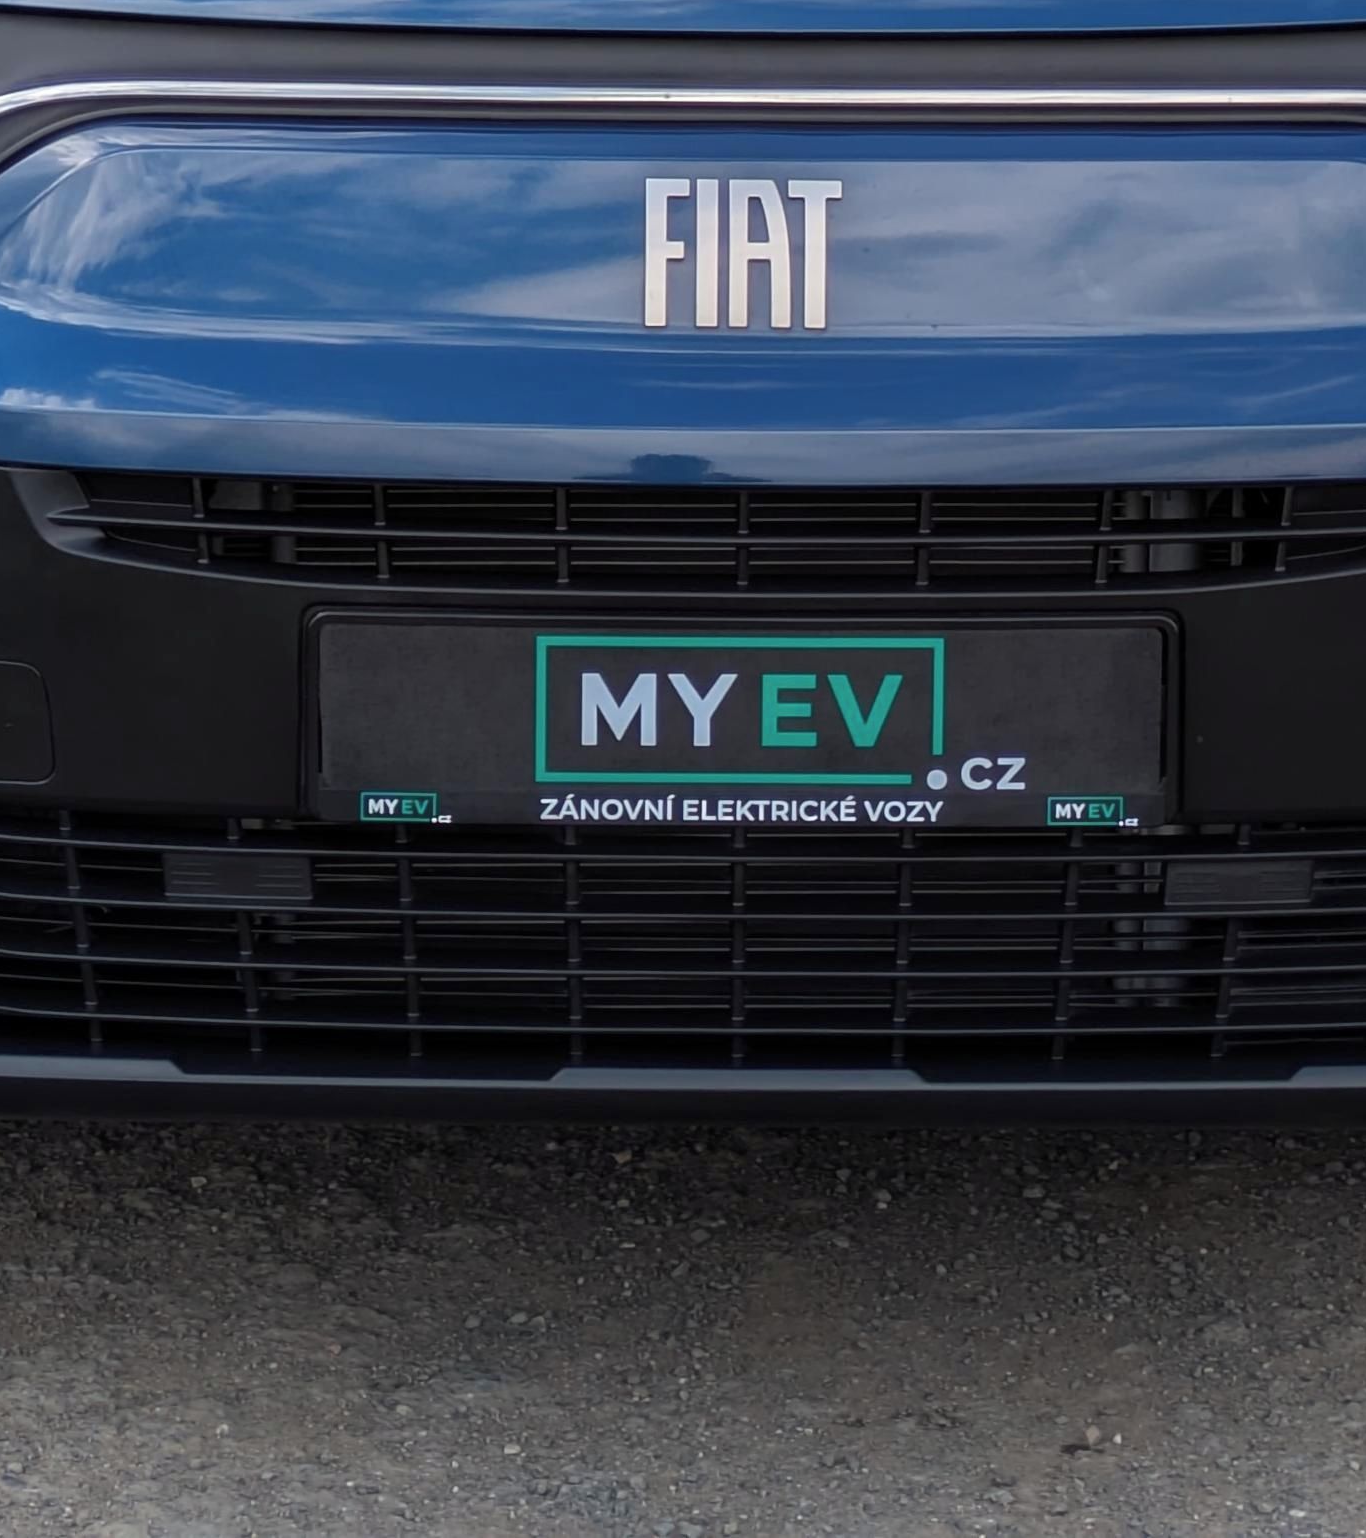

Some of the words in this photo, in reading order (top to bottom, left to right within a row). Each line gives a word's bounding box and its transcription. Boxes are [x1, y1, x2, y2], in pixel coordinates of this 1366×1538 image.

[644, 177, 843, 330] FIAT
[580, 672, 739, 747] MY
[761, 673, 904, 748] EV
[367, 798, 399, 815] MY
[401, 799, 429, 815] EV
[539, 793, 676, 821] ZÁNOVNÍ
[682, 794, 858, 822] ELEKTRICKÉ
[863, 800, 944, 823] VOZY
[1055, 803, 1086, 819] MY
[1088, 803, 1115, 819] EV
